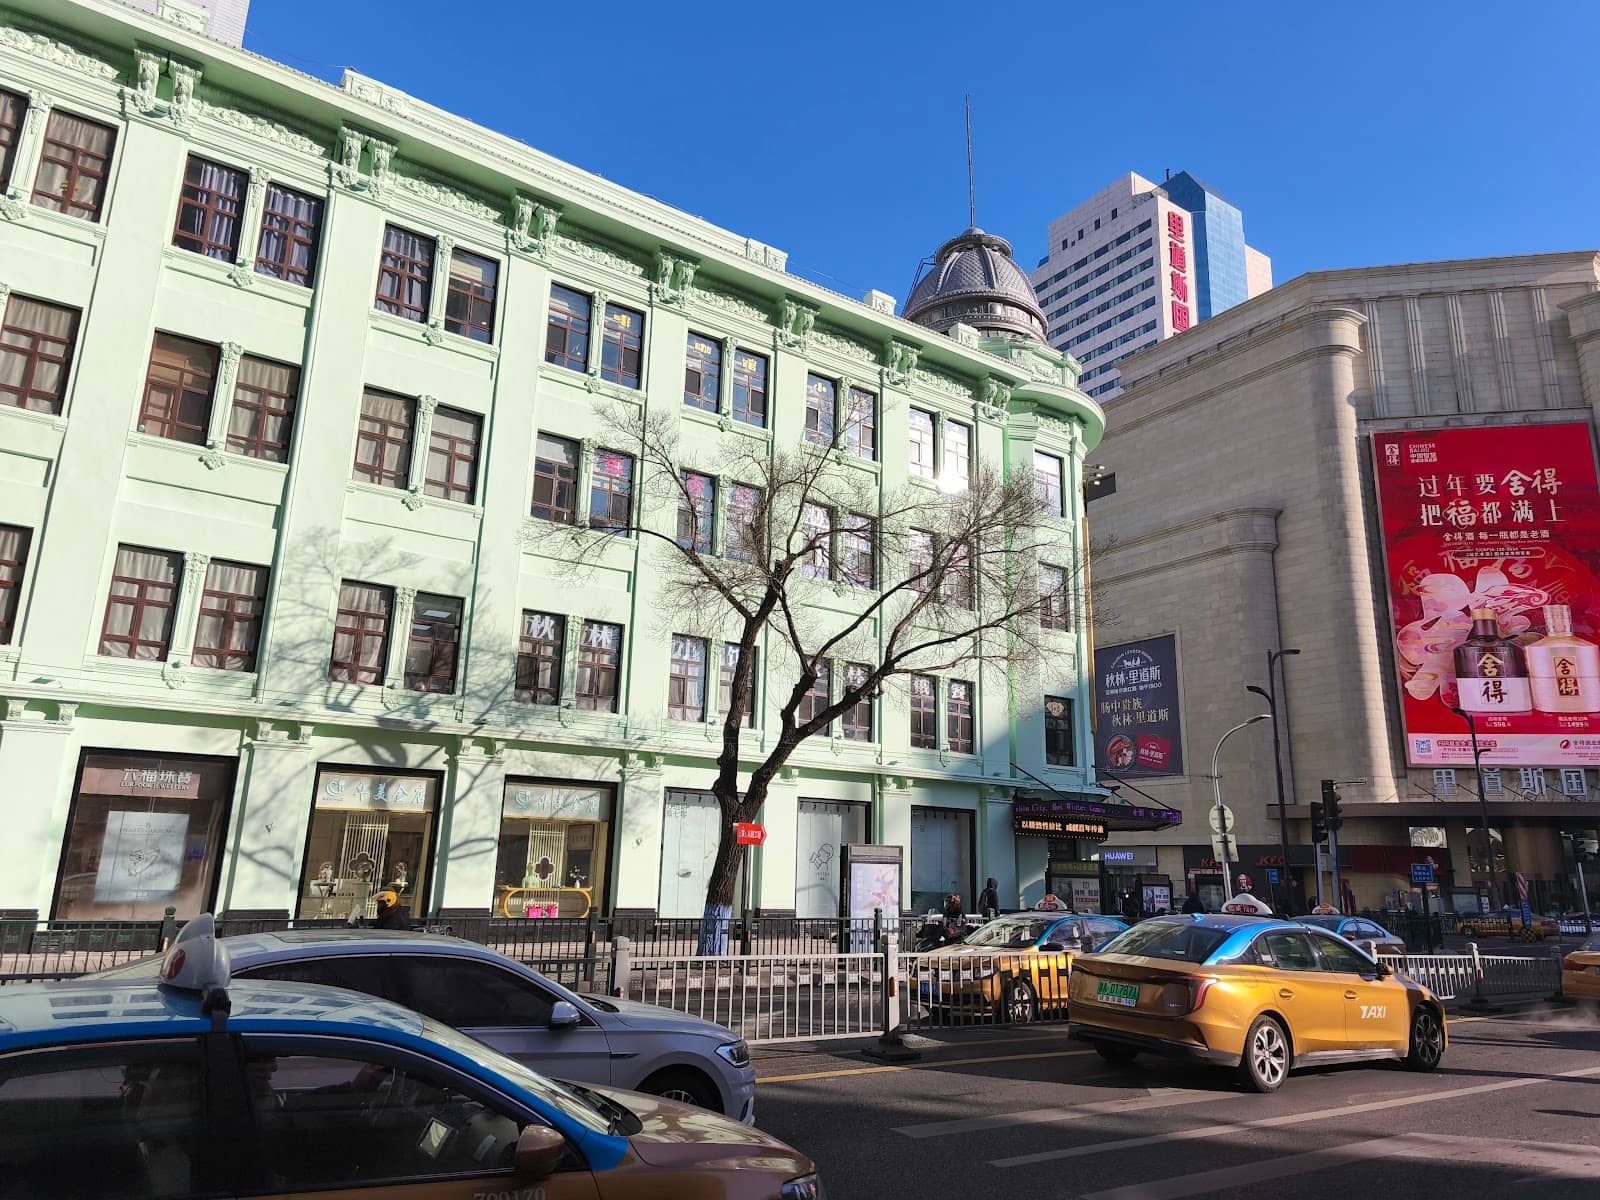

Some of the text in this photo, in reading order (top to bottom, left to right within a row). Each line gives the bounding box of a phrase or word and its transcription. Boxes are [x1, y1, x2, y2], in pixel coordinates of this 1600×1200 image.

[1417, 467, 1563, 498] 过年要舍得
[1419, 500, 1569, 528] 把福都满上
[1477, 652, 1508, 705] 舍得
[1555, 656, 1580, 697] 舍得
[1104, 851, 1134, 861] HUAWEI
[1360, 1004, 1386, 1020] TAXI
